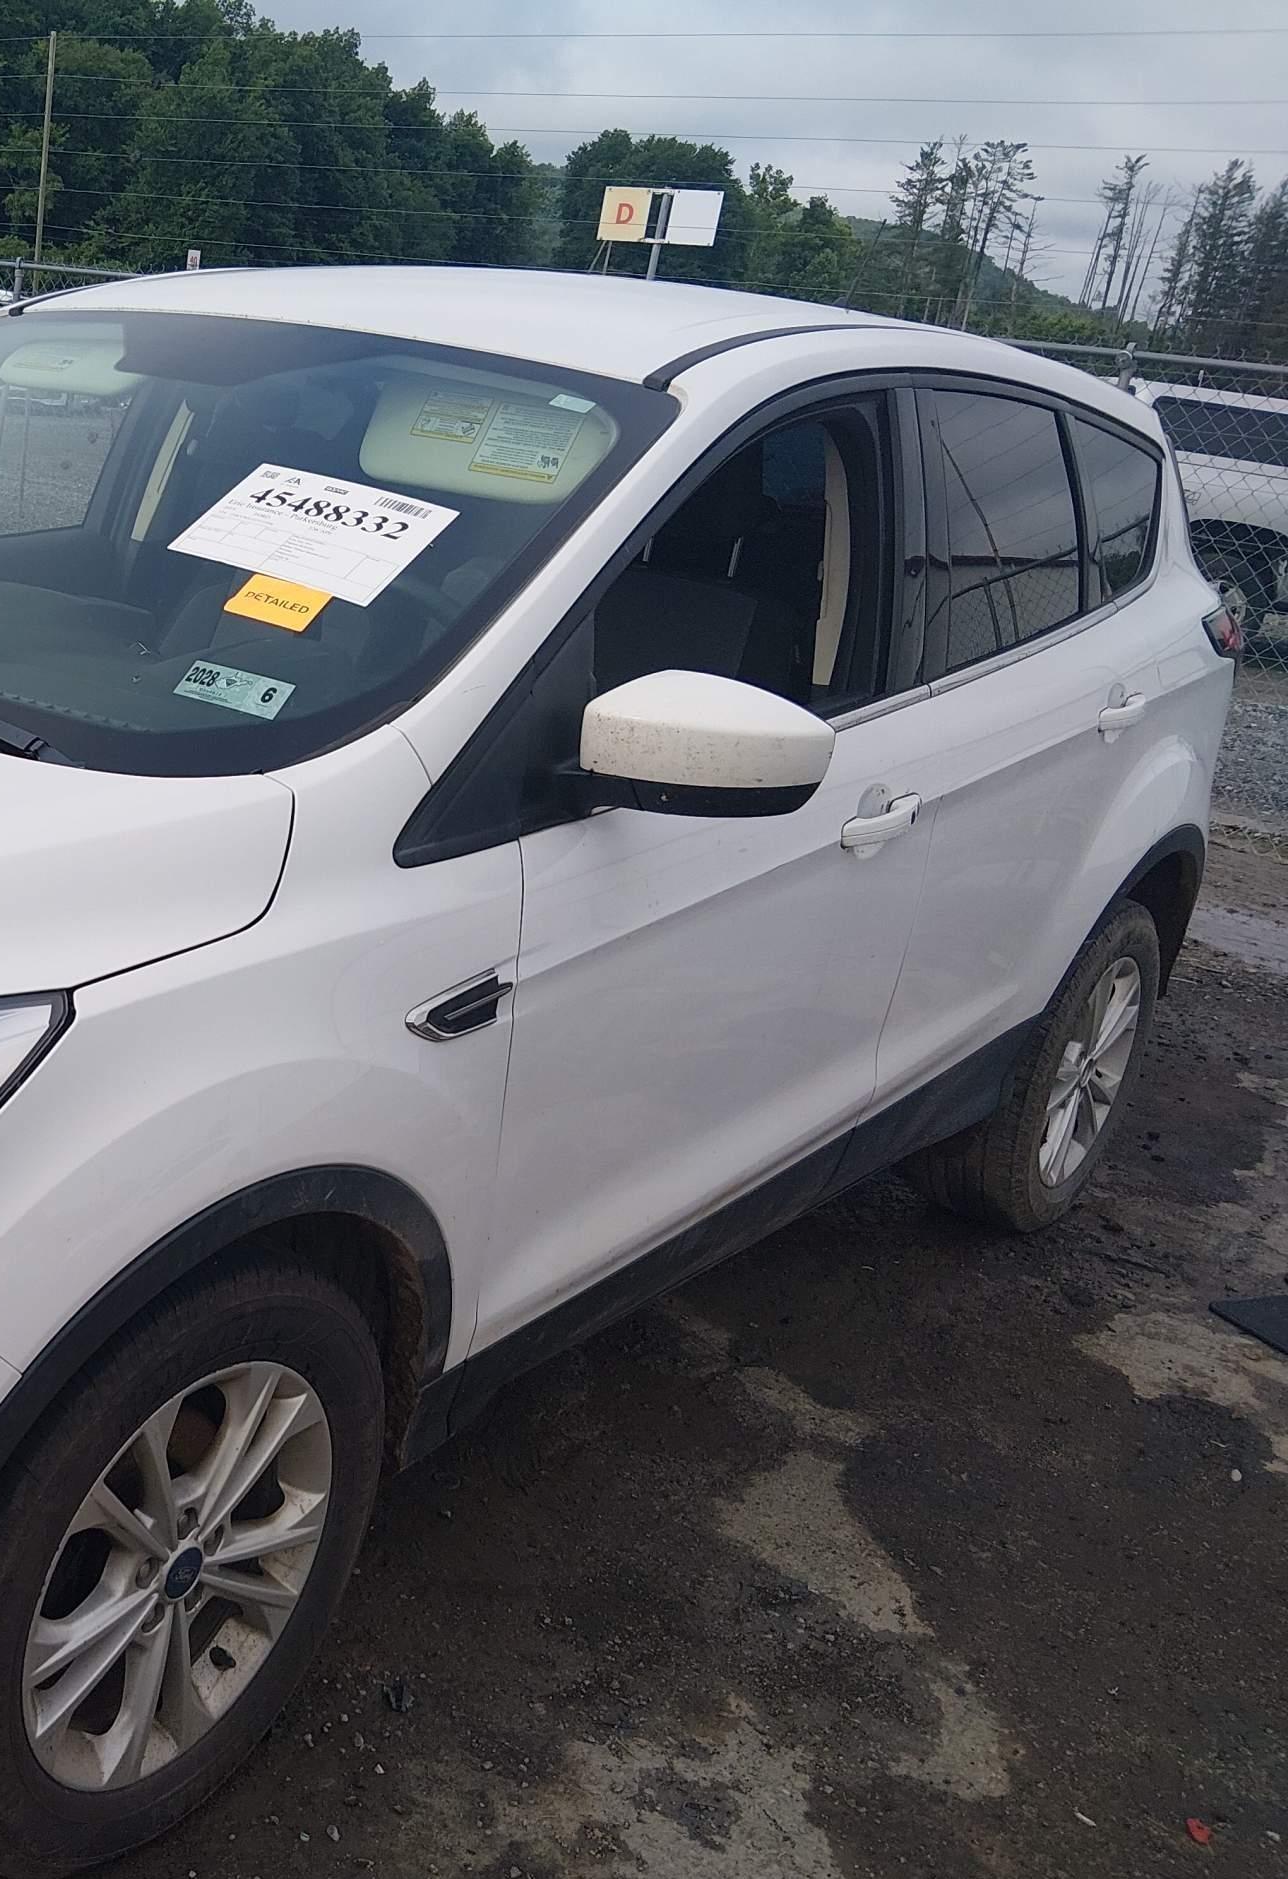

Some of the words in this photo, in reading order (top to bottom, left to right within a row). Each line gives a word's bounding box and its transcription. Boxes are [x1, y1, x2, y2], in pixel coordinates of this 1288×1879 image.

[615, 202, 634, 224] D
[249, 488, 409, 540] 45488332
[244, 591, 310, 614] DETAILED
[185, 666, 220, 687] 2028
[260, 687, 278, 704] 6
